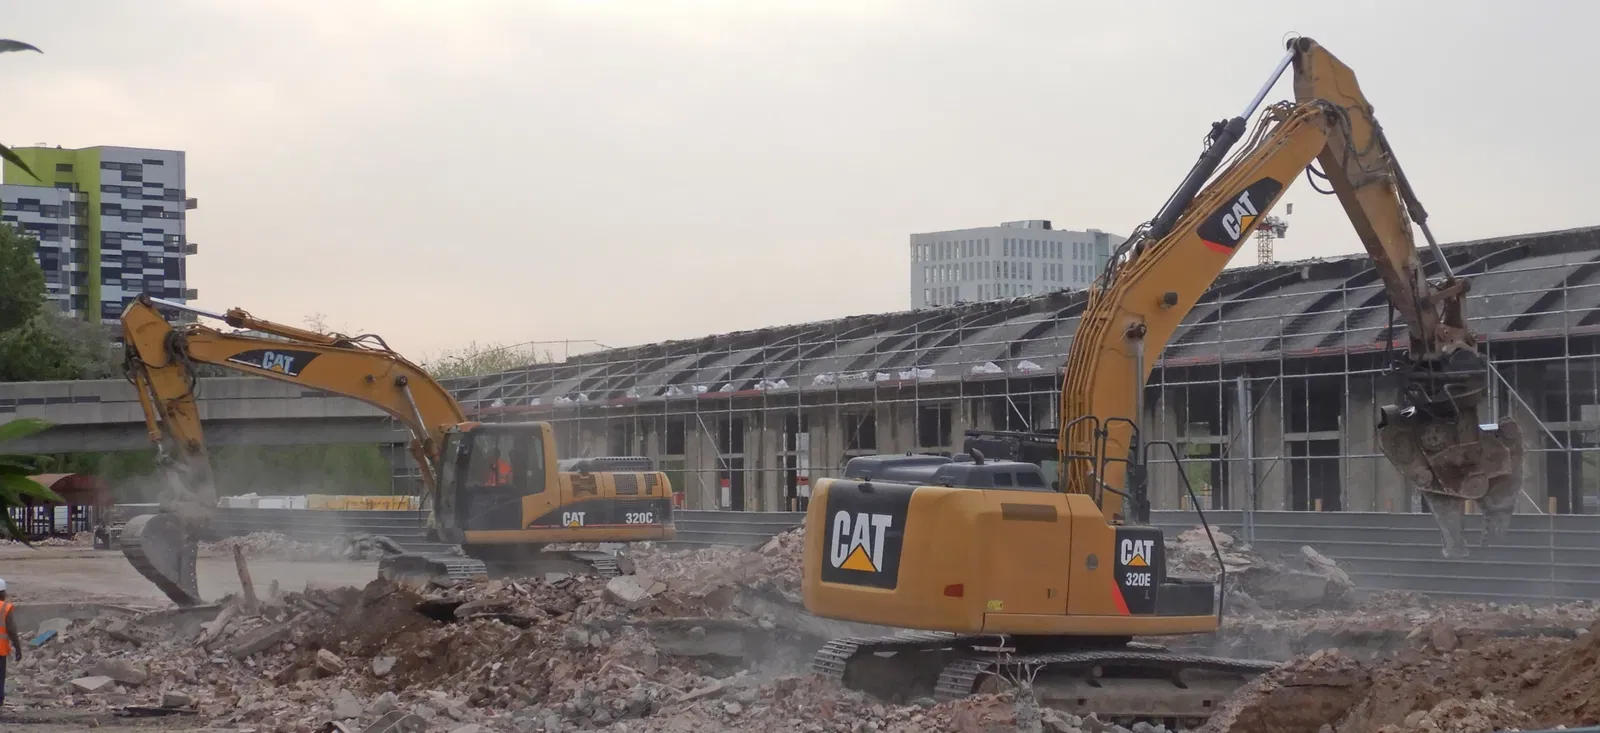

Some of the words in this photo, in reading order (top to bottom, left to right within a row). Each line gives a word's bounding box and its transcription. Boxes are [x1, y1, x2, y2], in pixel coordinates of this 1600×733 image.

[1222, 190, 1258, 240] CAT
[263, 351, 294, 374] CAT
[563, 512, 585, 527] CAT
[626, 512, 653, 524] 320C
[830, 510, 892, 572] CAT
[1120, 539, 1154, 566] CAT
[1126, 572, 1151, 586] 320E
